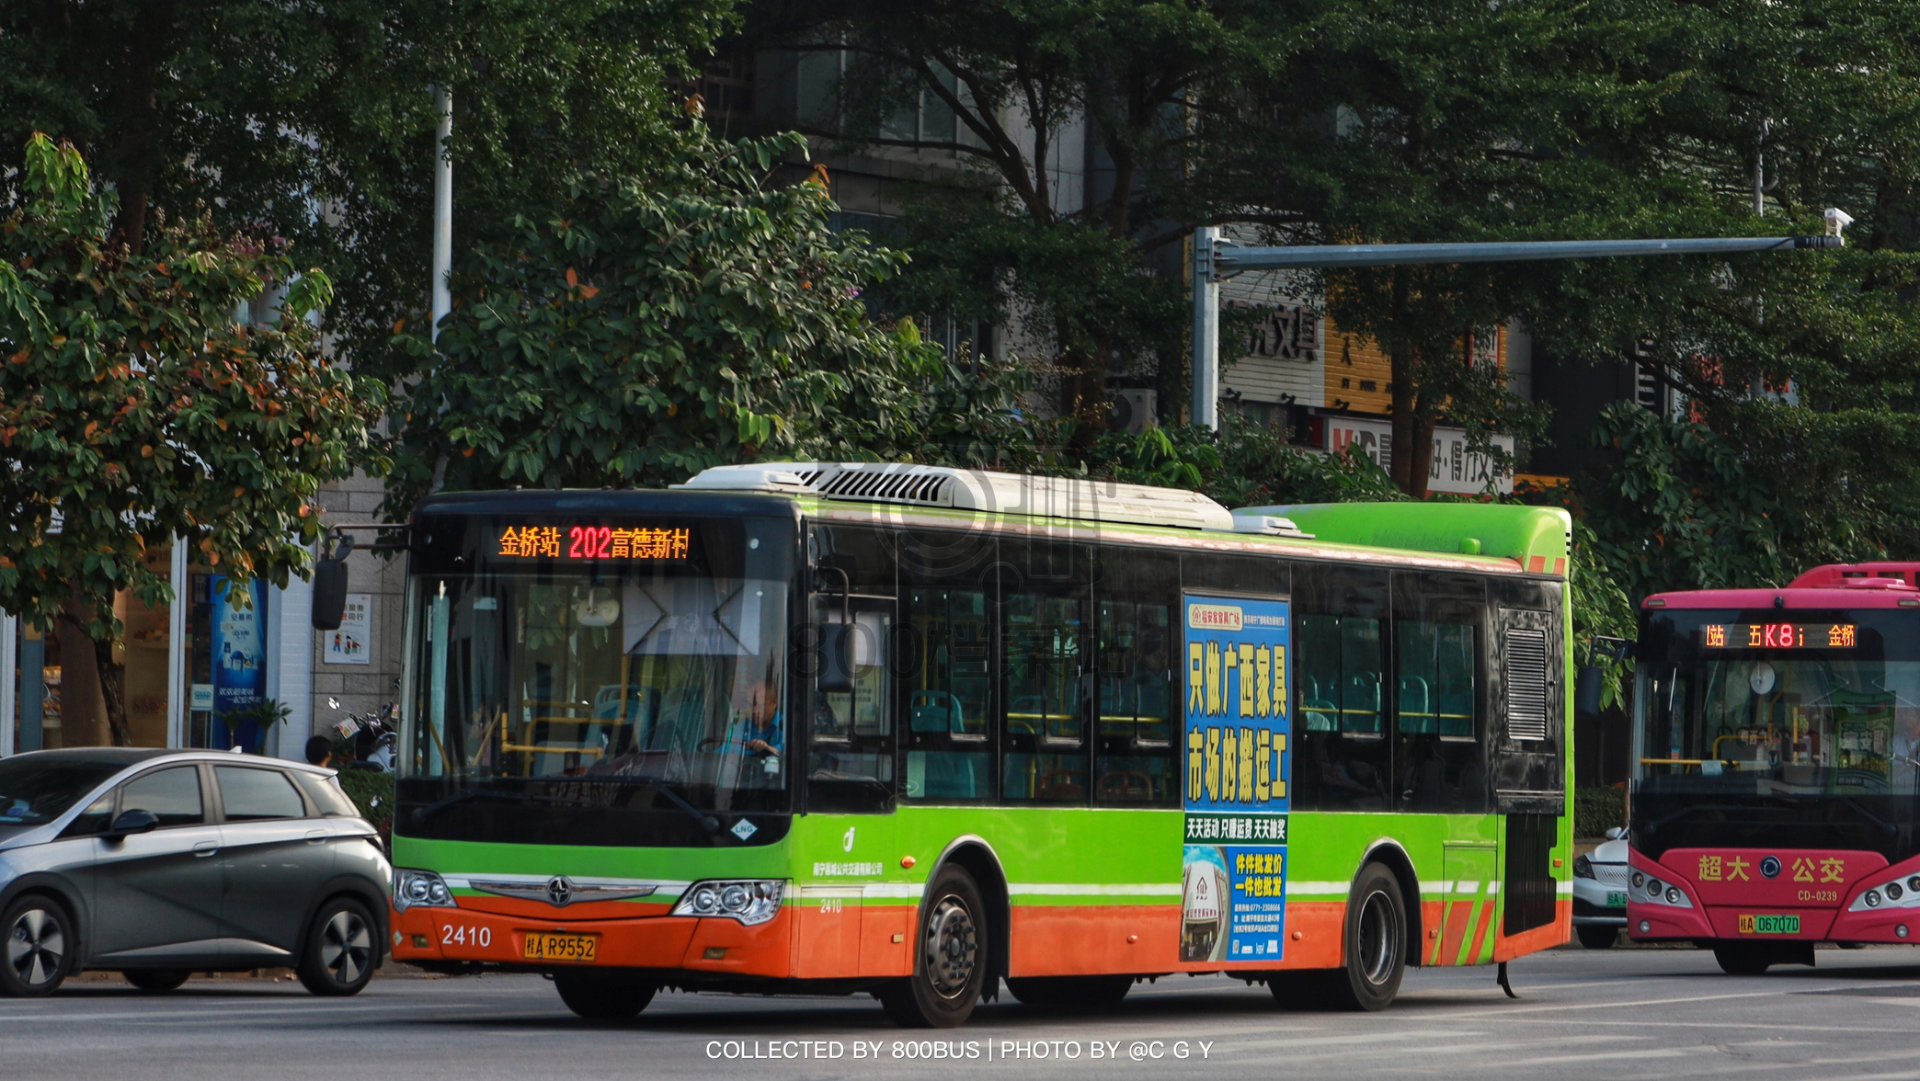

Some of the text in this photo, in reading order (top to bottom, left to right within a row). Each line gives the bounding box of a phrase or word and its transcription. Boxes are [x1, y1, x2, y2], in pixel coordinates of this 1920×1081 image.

[498, 526, 561, 557] 金桥站
[1187, 725, 1287, 804] 市场的搬运工
[735, 825, 753, 833] LNG
[1187, 818, 1220, 838] 天天活动
[1698, 855, 1845, 883] 超大 公交
[820, 898, 842, 914] 2410
[1798, 890, 1838, 902] CD-0239
[442, 925, 491, 947] 2410
